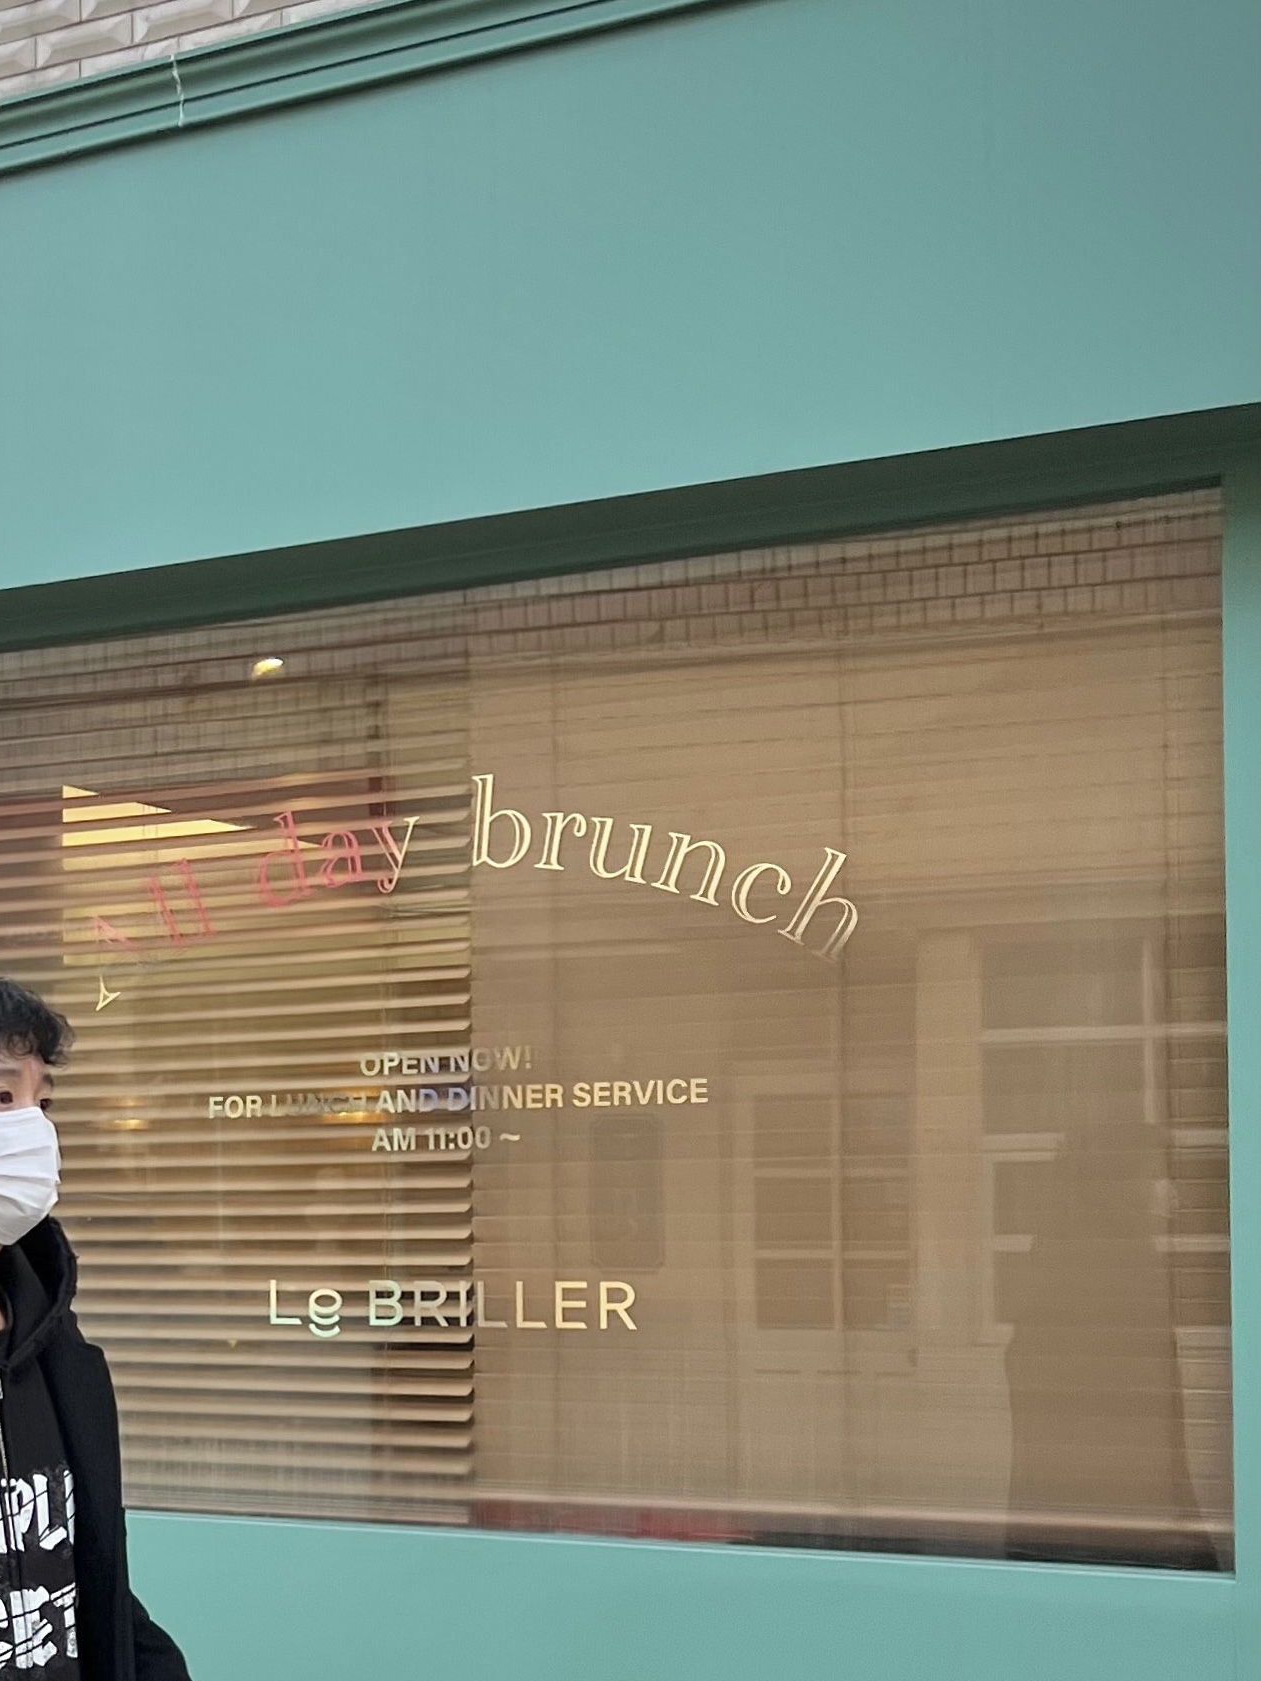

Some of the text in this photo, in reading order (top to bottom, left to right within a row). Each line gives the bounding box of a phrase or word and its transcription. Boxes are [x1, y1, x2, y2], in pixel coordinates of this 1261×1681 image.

[256, 810, 420, 907] day
[472, 774, 859, 963] brunch
[359, 1046, 533, 1077] OPEN NOW!
[208, 1095, 263, 1119] FOR
[376, 1087, 440, 1114] AND
[446, 1082, 564, 1112] DINNER
[571, 1077, 709, 1108] SERVICE
[371, 1127, 416, 1151] AM
[269, 1279, 638, 1338] Le BRILLER
